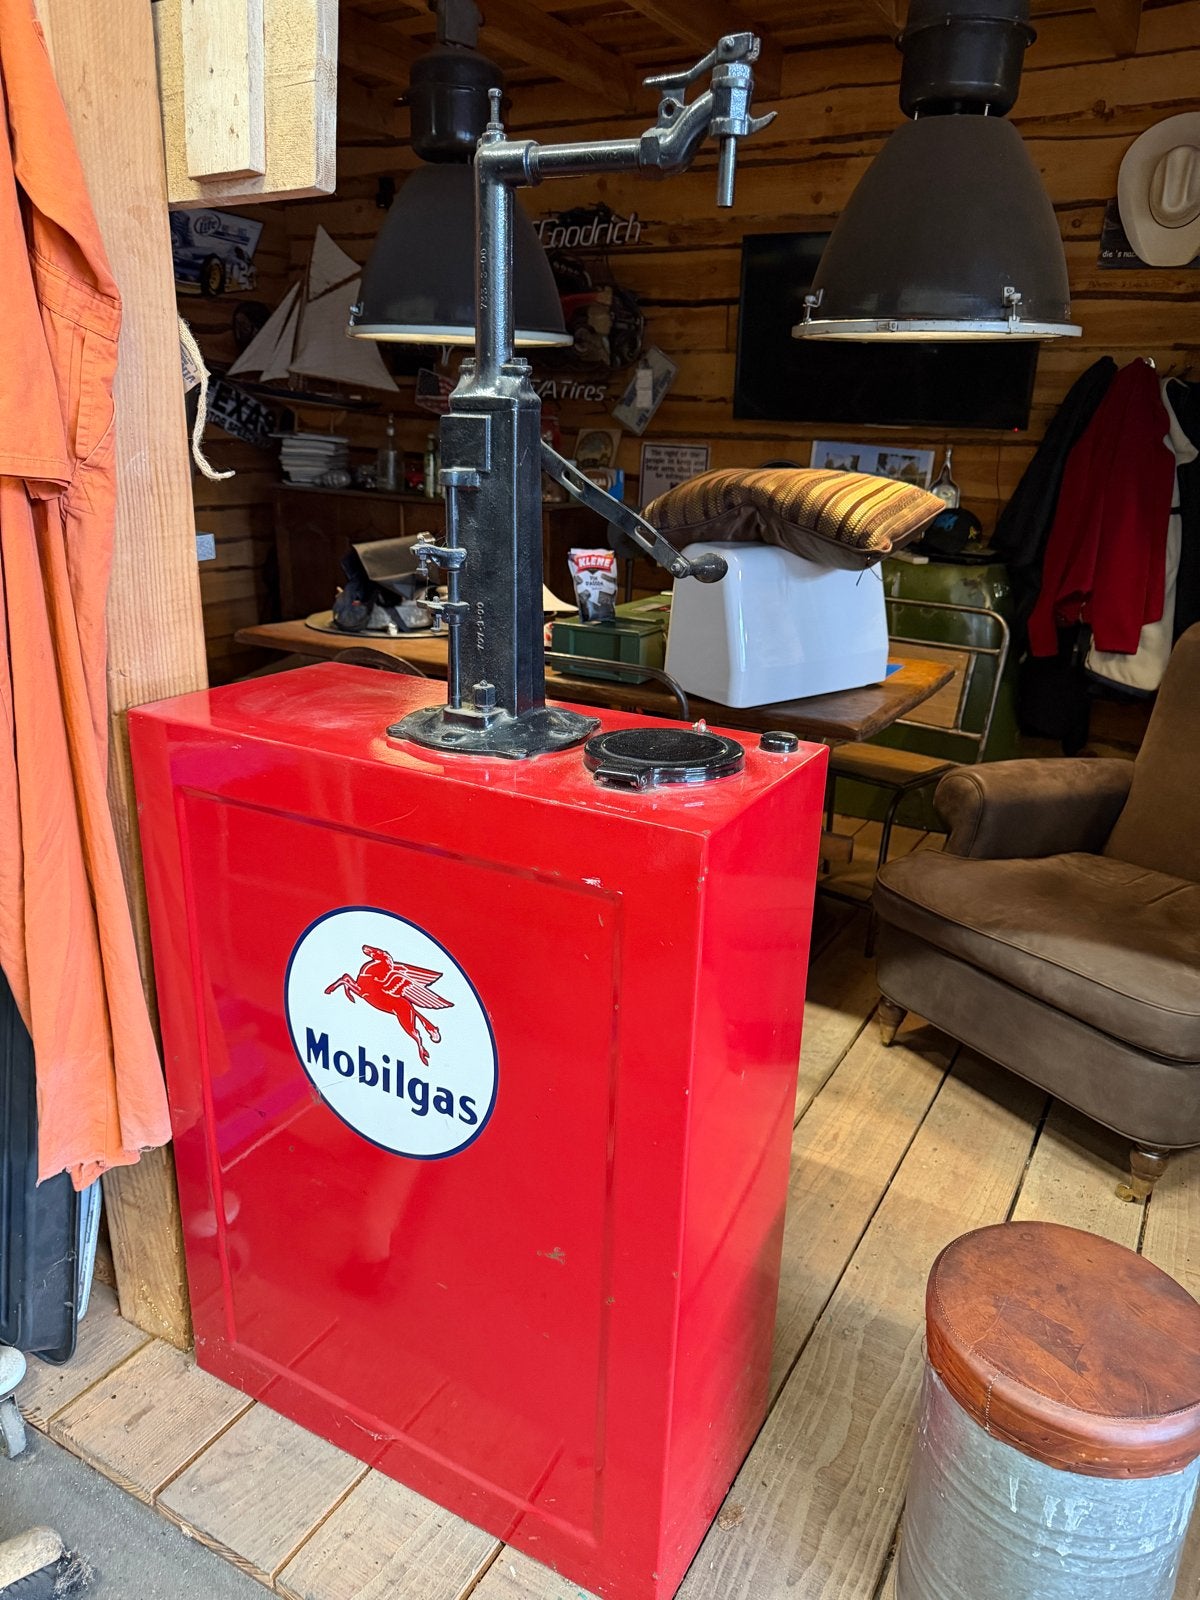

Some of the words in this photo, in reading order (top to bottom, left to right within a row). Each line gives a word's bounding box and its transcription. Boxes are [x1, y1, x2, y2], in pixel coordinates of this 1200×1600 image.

[532, 212, 641, 249] Goodrich
[560, 380, 607, 402] Tires
[578, 556, 611, 568] KLENE
[305, 1026, 479, 1126] Mobilgas
